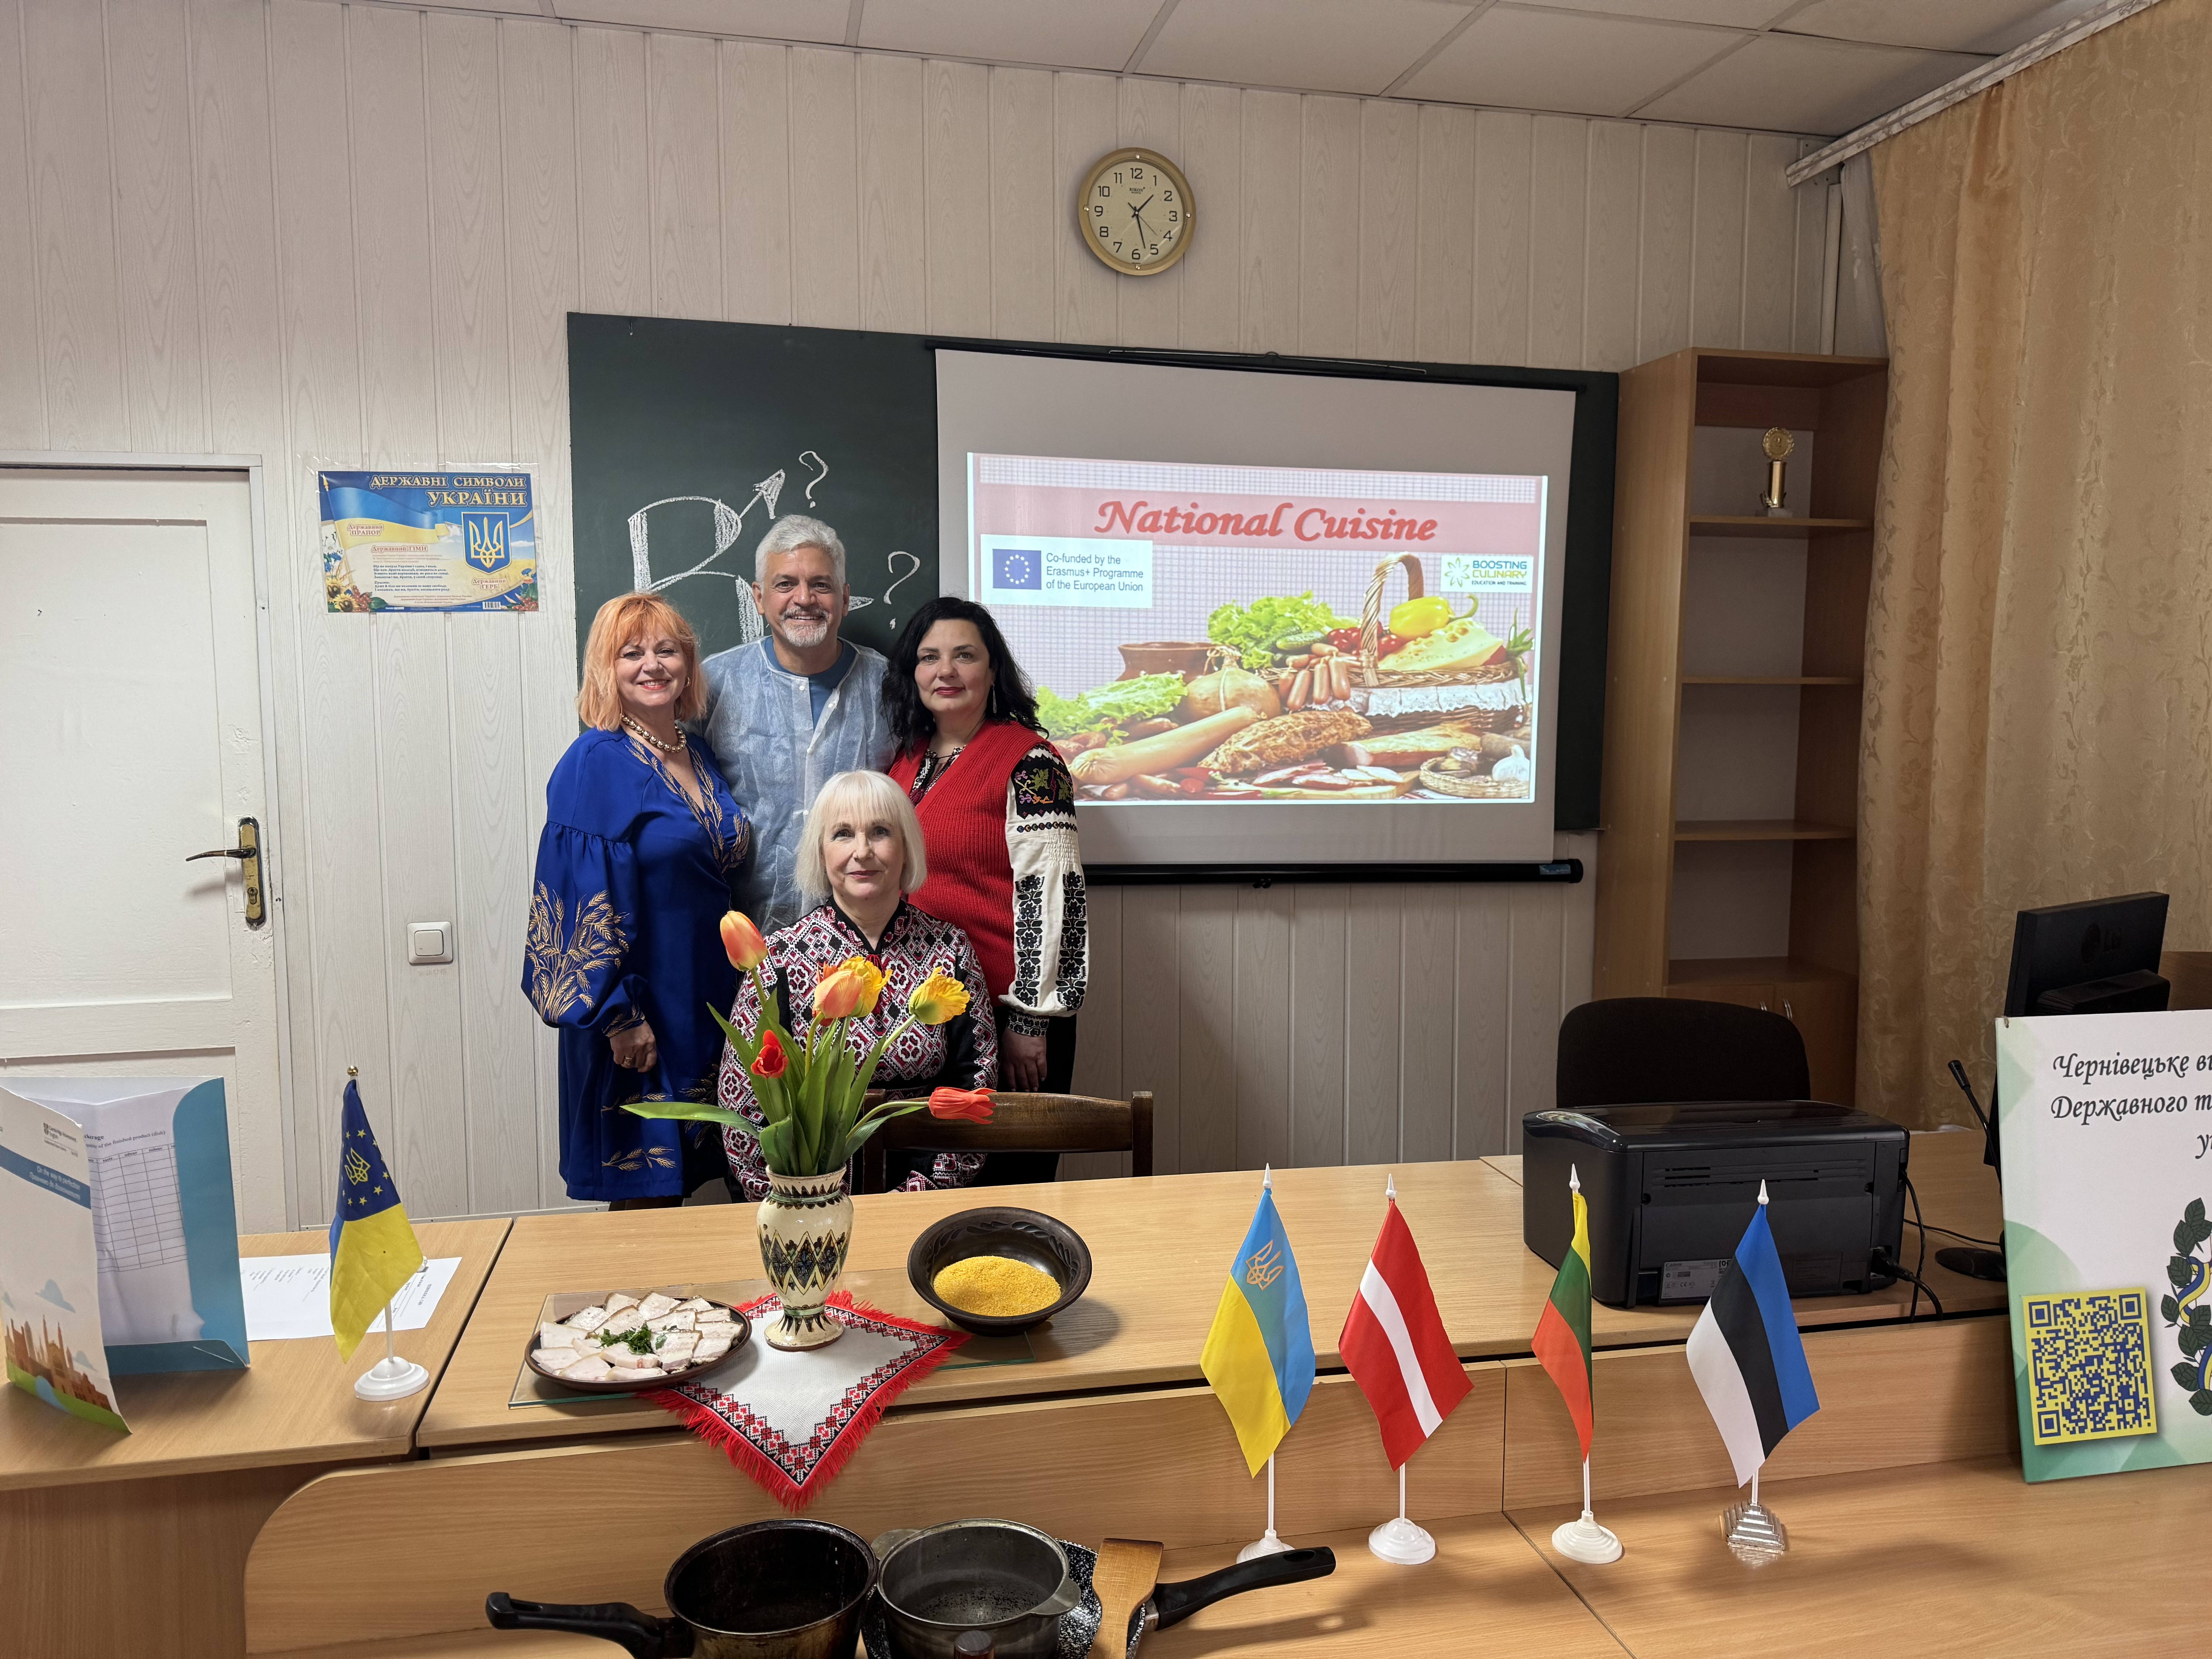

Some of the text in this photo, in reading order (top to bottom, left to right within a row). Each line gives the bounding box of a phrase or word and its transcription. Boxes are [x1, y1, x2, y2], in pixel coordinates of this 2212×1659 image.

[1114, 172, 1122, 184] 11
[1130, 168, 1143, 179] 12
[1153, 175, 1157, 186] 1
[1098, 186, 1110, 197] 10
[1164, 191, 1173, 201] 2
[1094, 206, 1103, 216] 9
[1169, 211, 1178, 222] 3
[1100, 227, 1108, 237] 8
[1163, 230, 1173, 241] 4
[1113, 242, 1122, 252] 7
[1150, 244, 1158, 255] 5
[1132, 249, 1140, 260] 6
[371, 476, 526, 489] ДЕРЖАВНІ СИМВОЛИ
[427, 489, 527, 507] УКРАЇНИ
[1094, 500, 1438, 541] National Cuisine
[1046, 553, 1121, 566] Co-funded by the
[1473, 560, 1527, 569] BOOSTING
[1047, 566, 1143, 579] Erasmus+ Programme
[1472, 570, 1527, 579] CULINARY
[1046, 579, 1143, 592] of the European Union
[2053, 1052, 2190, 1085] Чернівецьке
[2051, 1096, 2188, 1125] Державного
